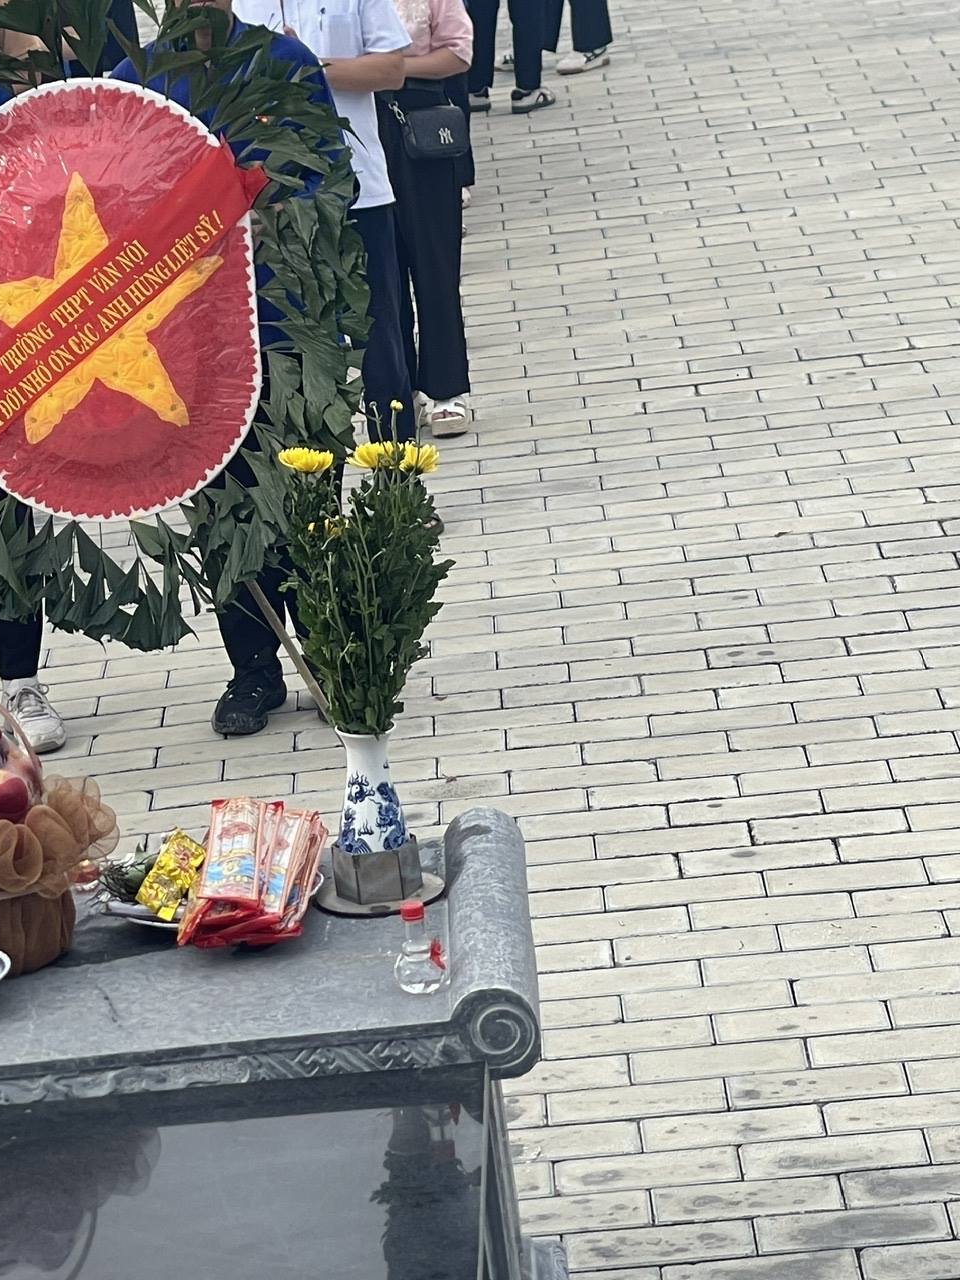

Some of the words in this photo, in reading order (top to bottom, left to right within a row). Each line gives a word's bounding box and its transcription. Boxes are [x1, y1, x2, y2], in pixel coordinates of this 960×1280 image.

[18, 359, 53, 399] NHỚ
[48, 344, 76, 373] ƠN
[68, 322, 100, 355] CÁC
[97, 294, 133, 333] ANH
[125, 260, 172, 306] HÙNG
[163, 232, 200, 272] LIỆT
[50, 286, 94, 328] THPT
[87, 261, 123, 294] VÂN
[115, 239, 149, 272] NỘI
